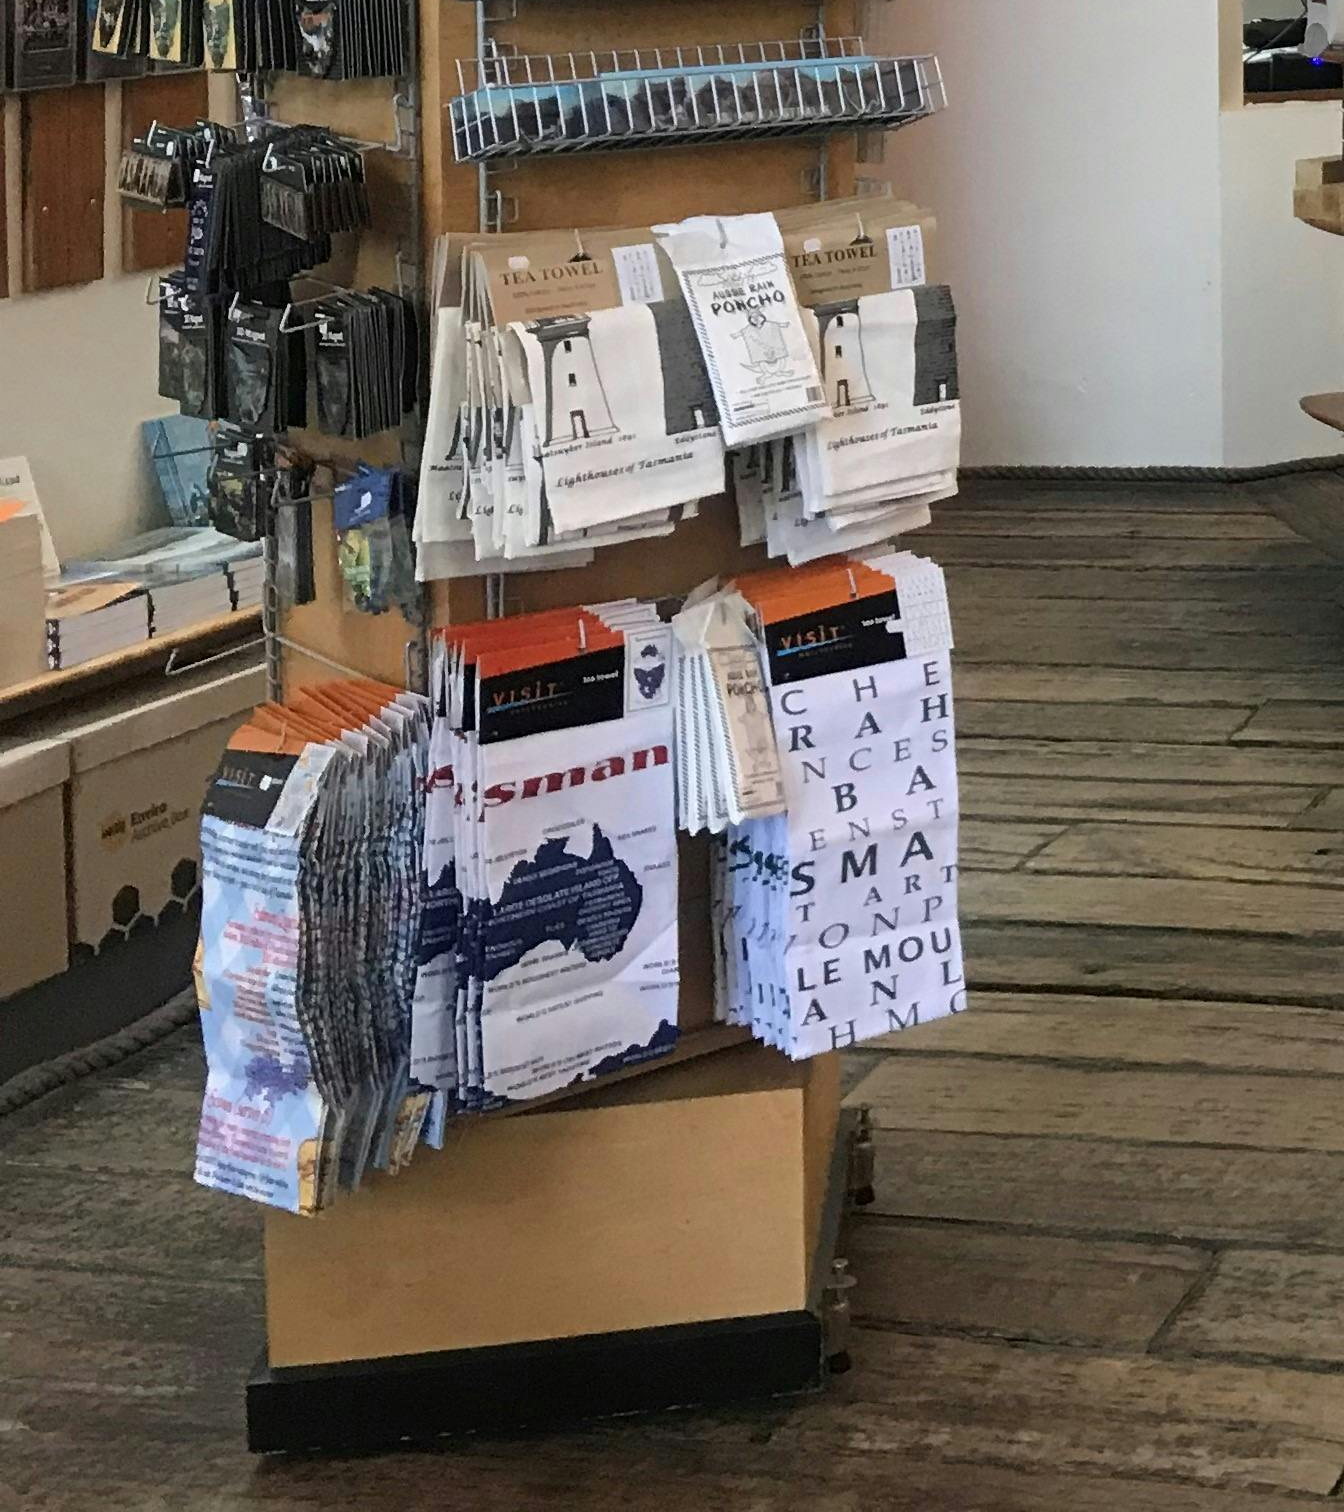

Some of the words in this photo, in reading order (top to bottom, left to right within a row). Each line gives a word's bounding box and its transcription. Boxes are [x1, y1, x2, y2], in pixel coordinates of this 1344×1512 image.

[793, 250, 822, 268] TEA
[827, 245, 878, 263] TOWEL
[499, 269, 536, 286] TEA
[538, 261, 604, 282] TOWEL
[749, 280, 775, 295] RAIN
[711, 289, 786, 317] PONCHO
[827, 433, 879, 452] Lighthouses
[891, 421, 939, 436] Tasmania
[556, 465, 625, 489] Lighthouses
[624, 461, 636, 475] of
[639, 450, 694, 471] Tasmania
[484, 744, 669, 809] sman
[130, 803, 168, 827] Enviro
